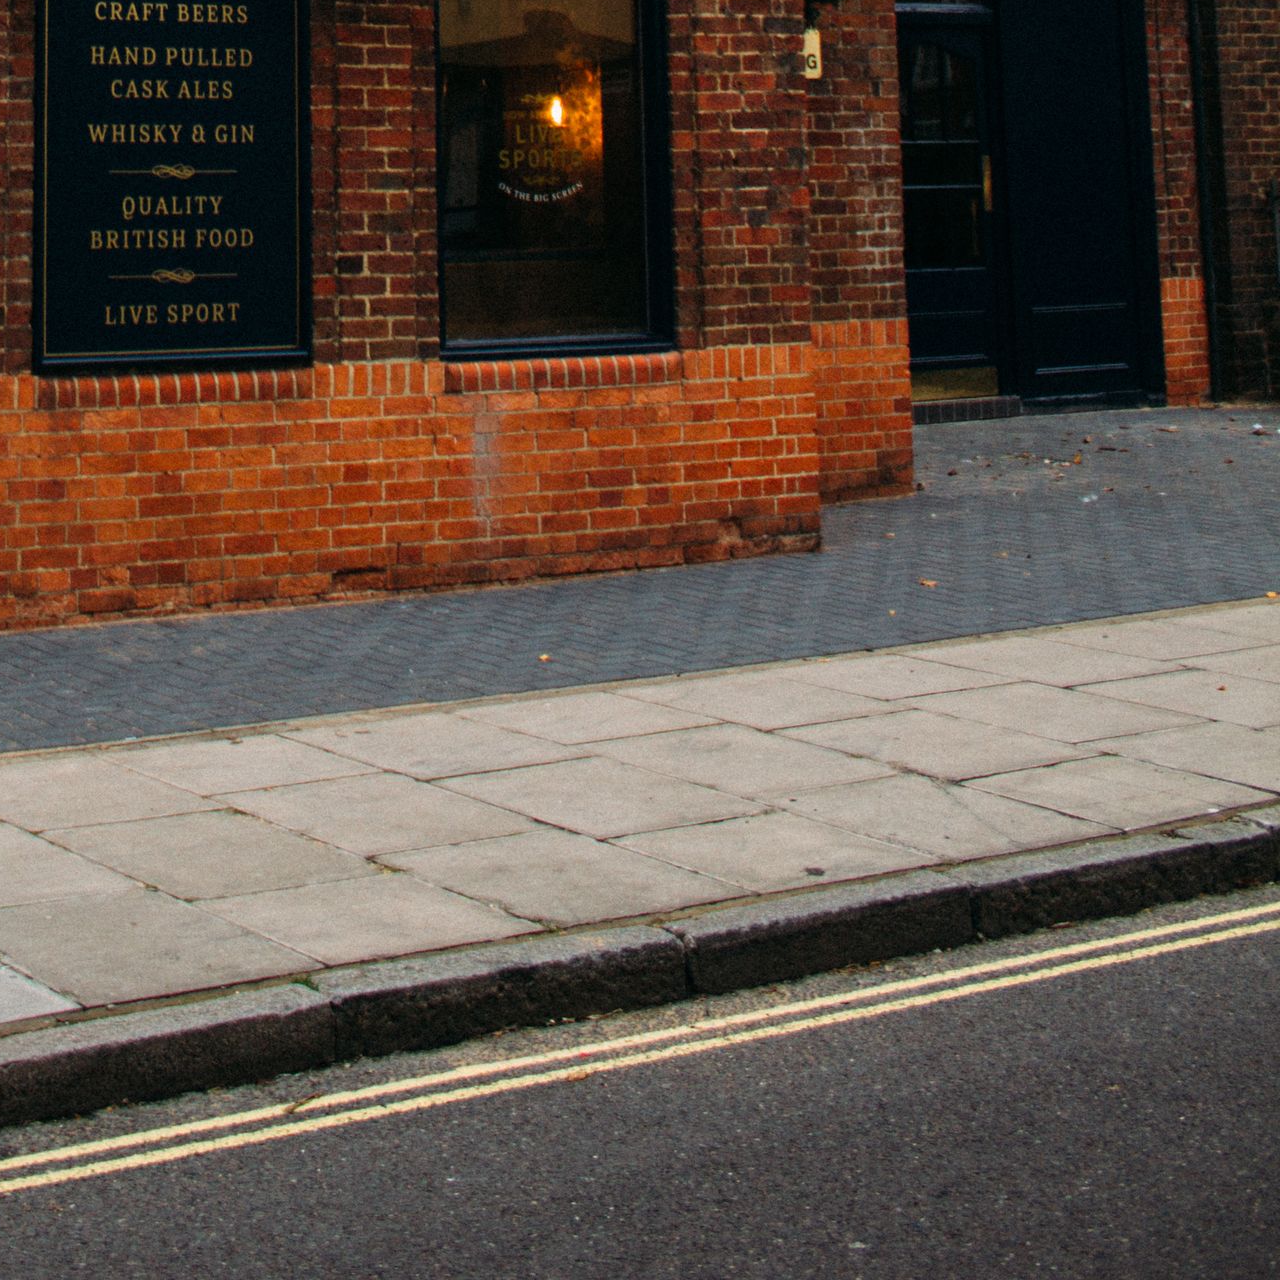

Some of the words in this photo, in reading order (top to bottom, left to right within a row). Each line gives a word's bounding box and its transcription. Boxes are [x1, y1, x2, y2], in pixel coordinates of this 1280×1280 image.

[94, 1, 169, 23] CRAFT
[177, 3, 249, 24] BEERS
[90, 45, 158, 66] HAND
[165, 47, 254, 68] PULLED
[111, 79, 170, 99] CASK
[178, 80, 234, 100] ALES
[88, 123, 183, 144] WHISKY
[191, 124, 207, 143] &
[215, 124, 255, 144] GIN
[498, 182, 513, 195] ON
[514, 191, 532, 202] THE
[533, 193, 550, 203] BIG
[551, 180, 584, 202] SCREEN
[122, 195, 224, 219] QUALITY
[90, 229, 187, 250] BRITISH
[195, 228, 255, 249] FOOD
[105, 304, 159, 325] LIVE
[167, 302, 241, 324] SPORT
